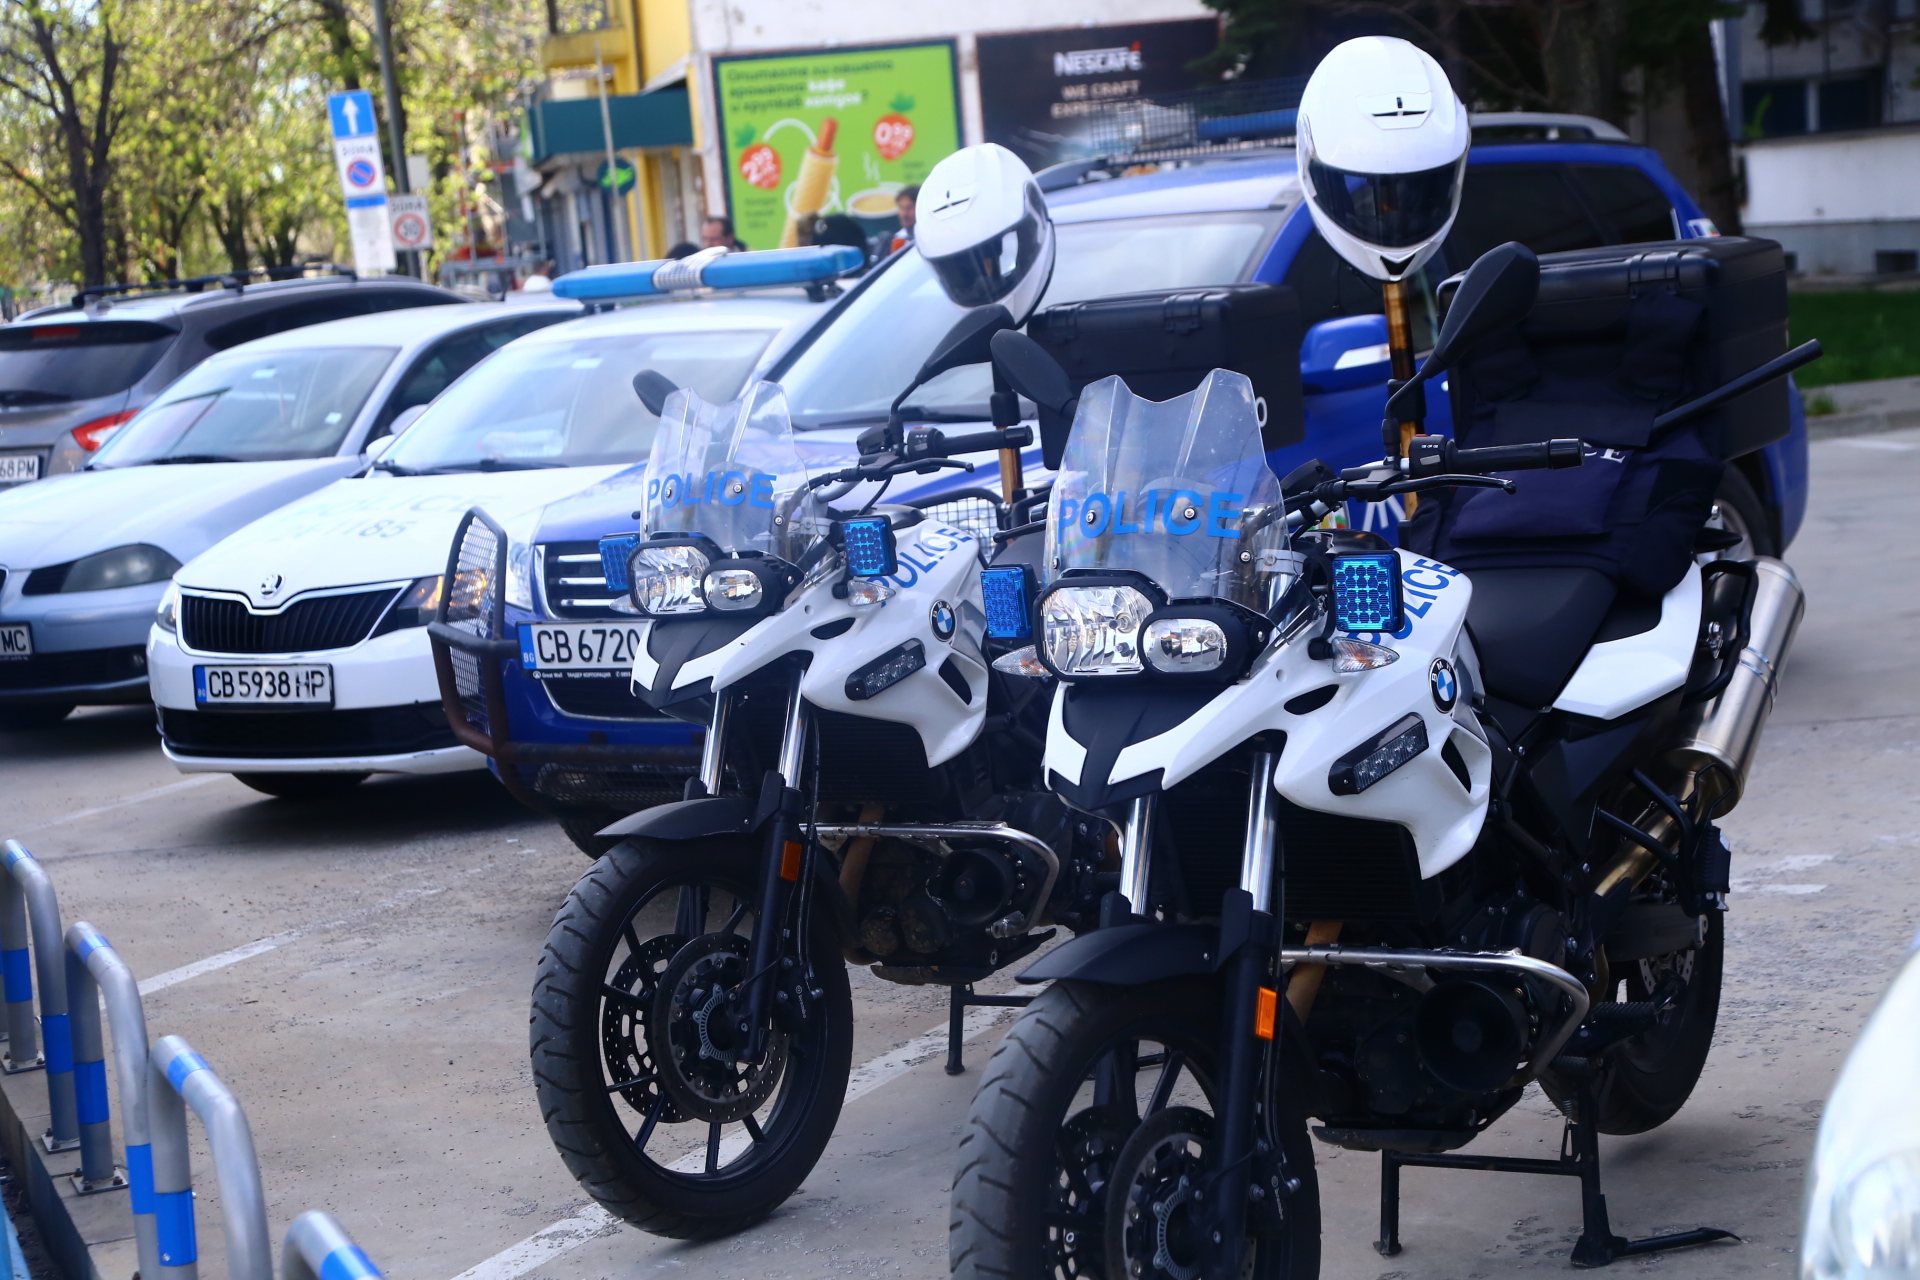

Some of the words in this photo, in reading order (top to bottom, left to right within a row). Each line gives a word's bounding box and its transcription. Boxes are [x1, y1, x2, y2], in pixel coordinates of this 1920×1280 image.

[807, 78, 846, 93] кафе
[1061, 84, 1088, 100] WE
[1090, 79, 1140, 98] CRAFT
[17, 459, 35, 476] PM
[648, 471, 777, 511] POLICE
[1058, 489, 1244, 544] POLICE
[1, 629, 26, 652] MC
[523, 652, 535, 662] BG
[537, 630, 572, 663] CB
[578, 628, 641, 663] 6720
[208, 670, 235, 698] CB
[238, 670, 291, 698] 5938
